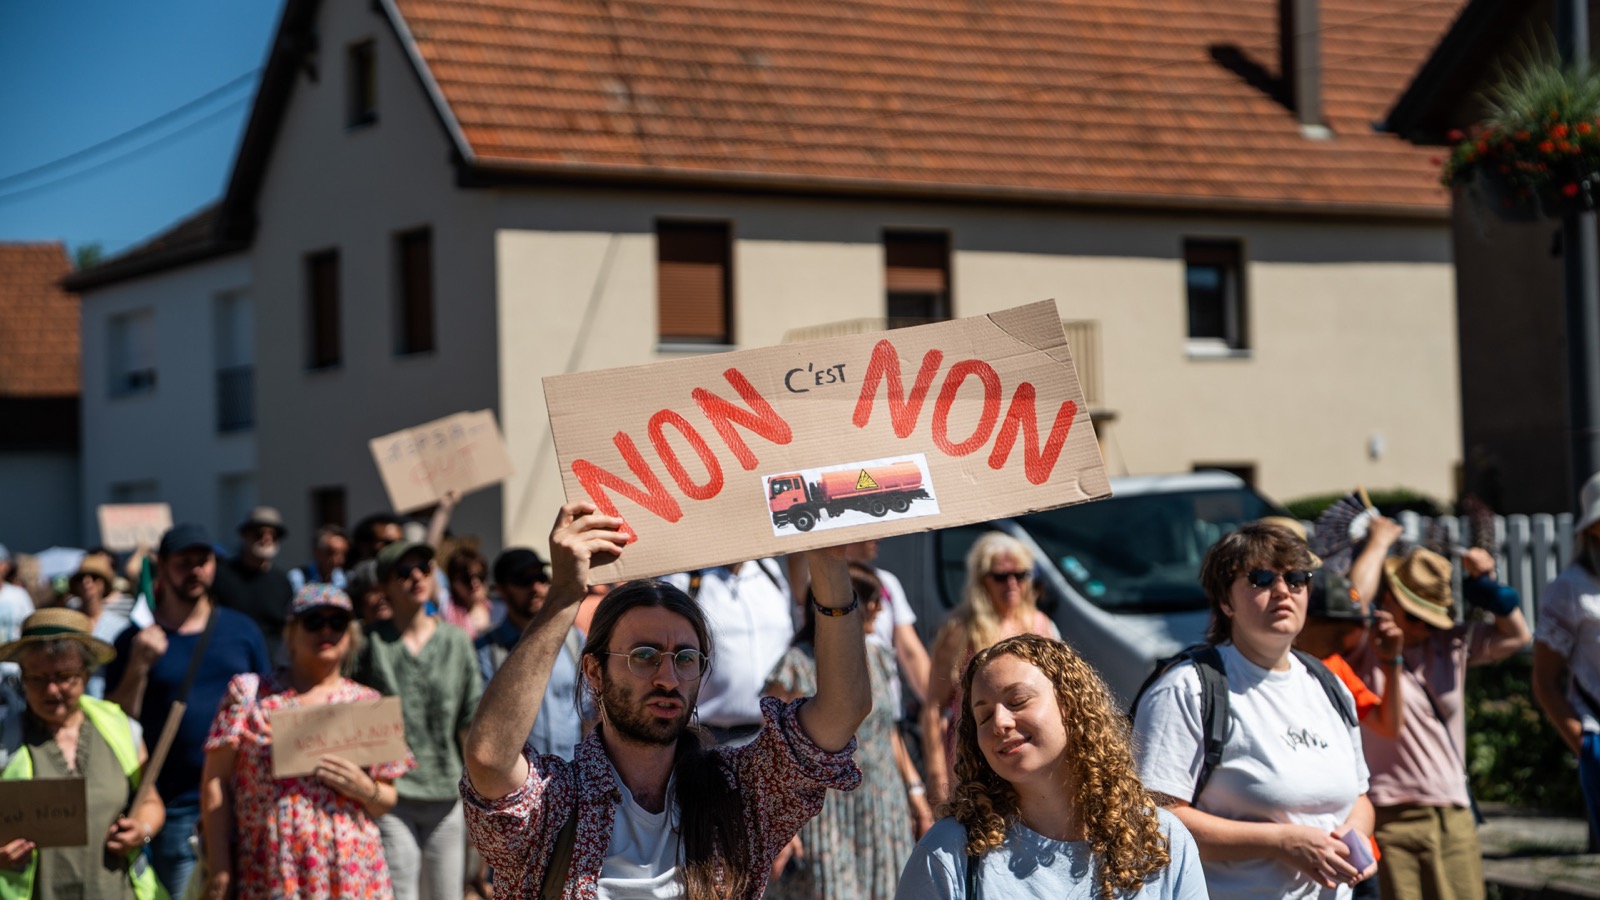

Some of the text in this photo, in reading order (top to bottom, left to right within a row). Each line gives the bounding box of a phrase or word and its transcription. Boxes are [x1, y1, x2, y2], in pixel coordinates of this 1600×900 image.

[571, 339, 1078, 545] NON C'EST NON
